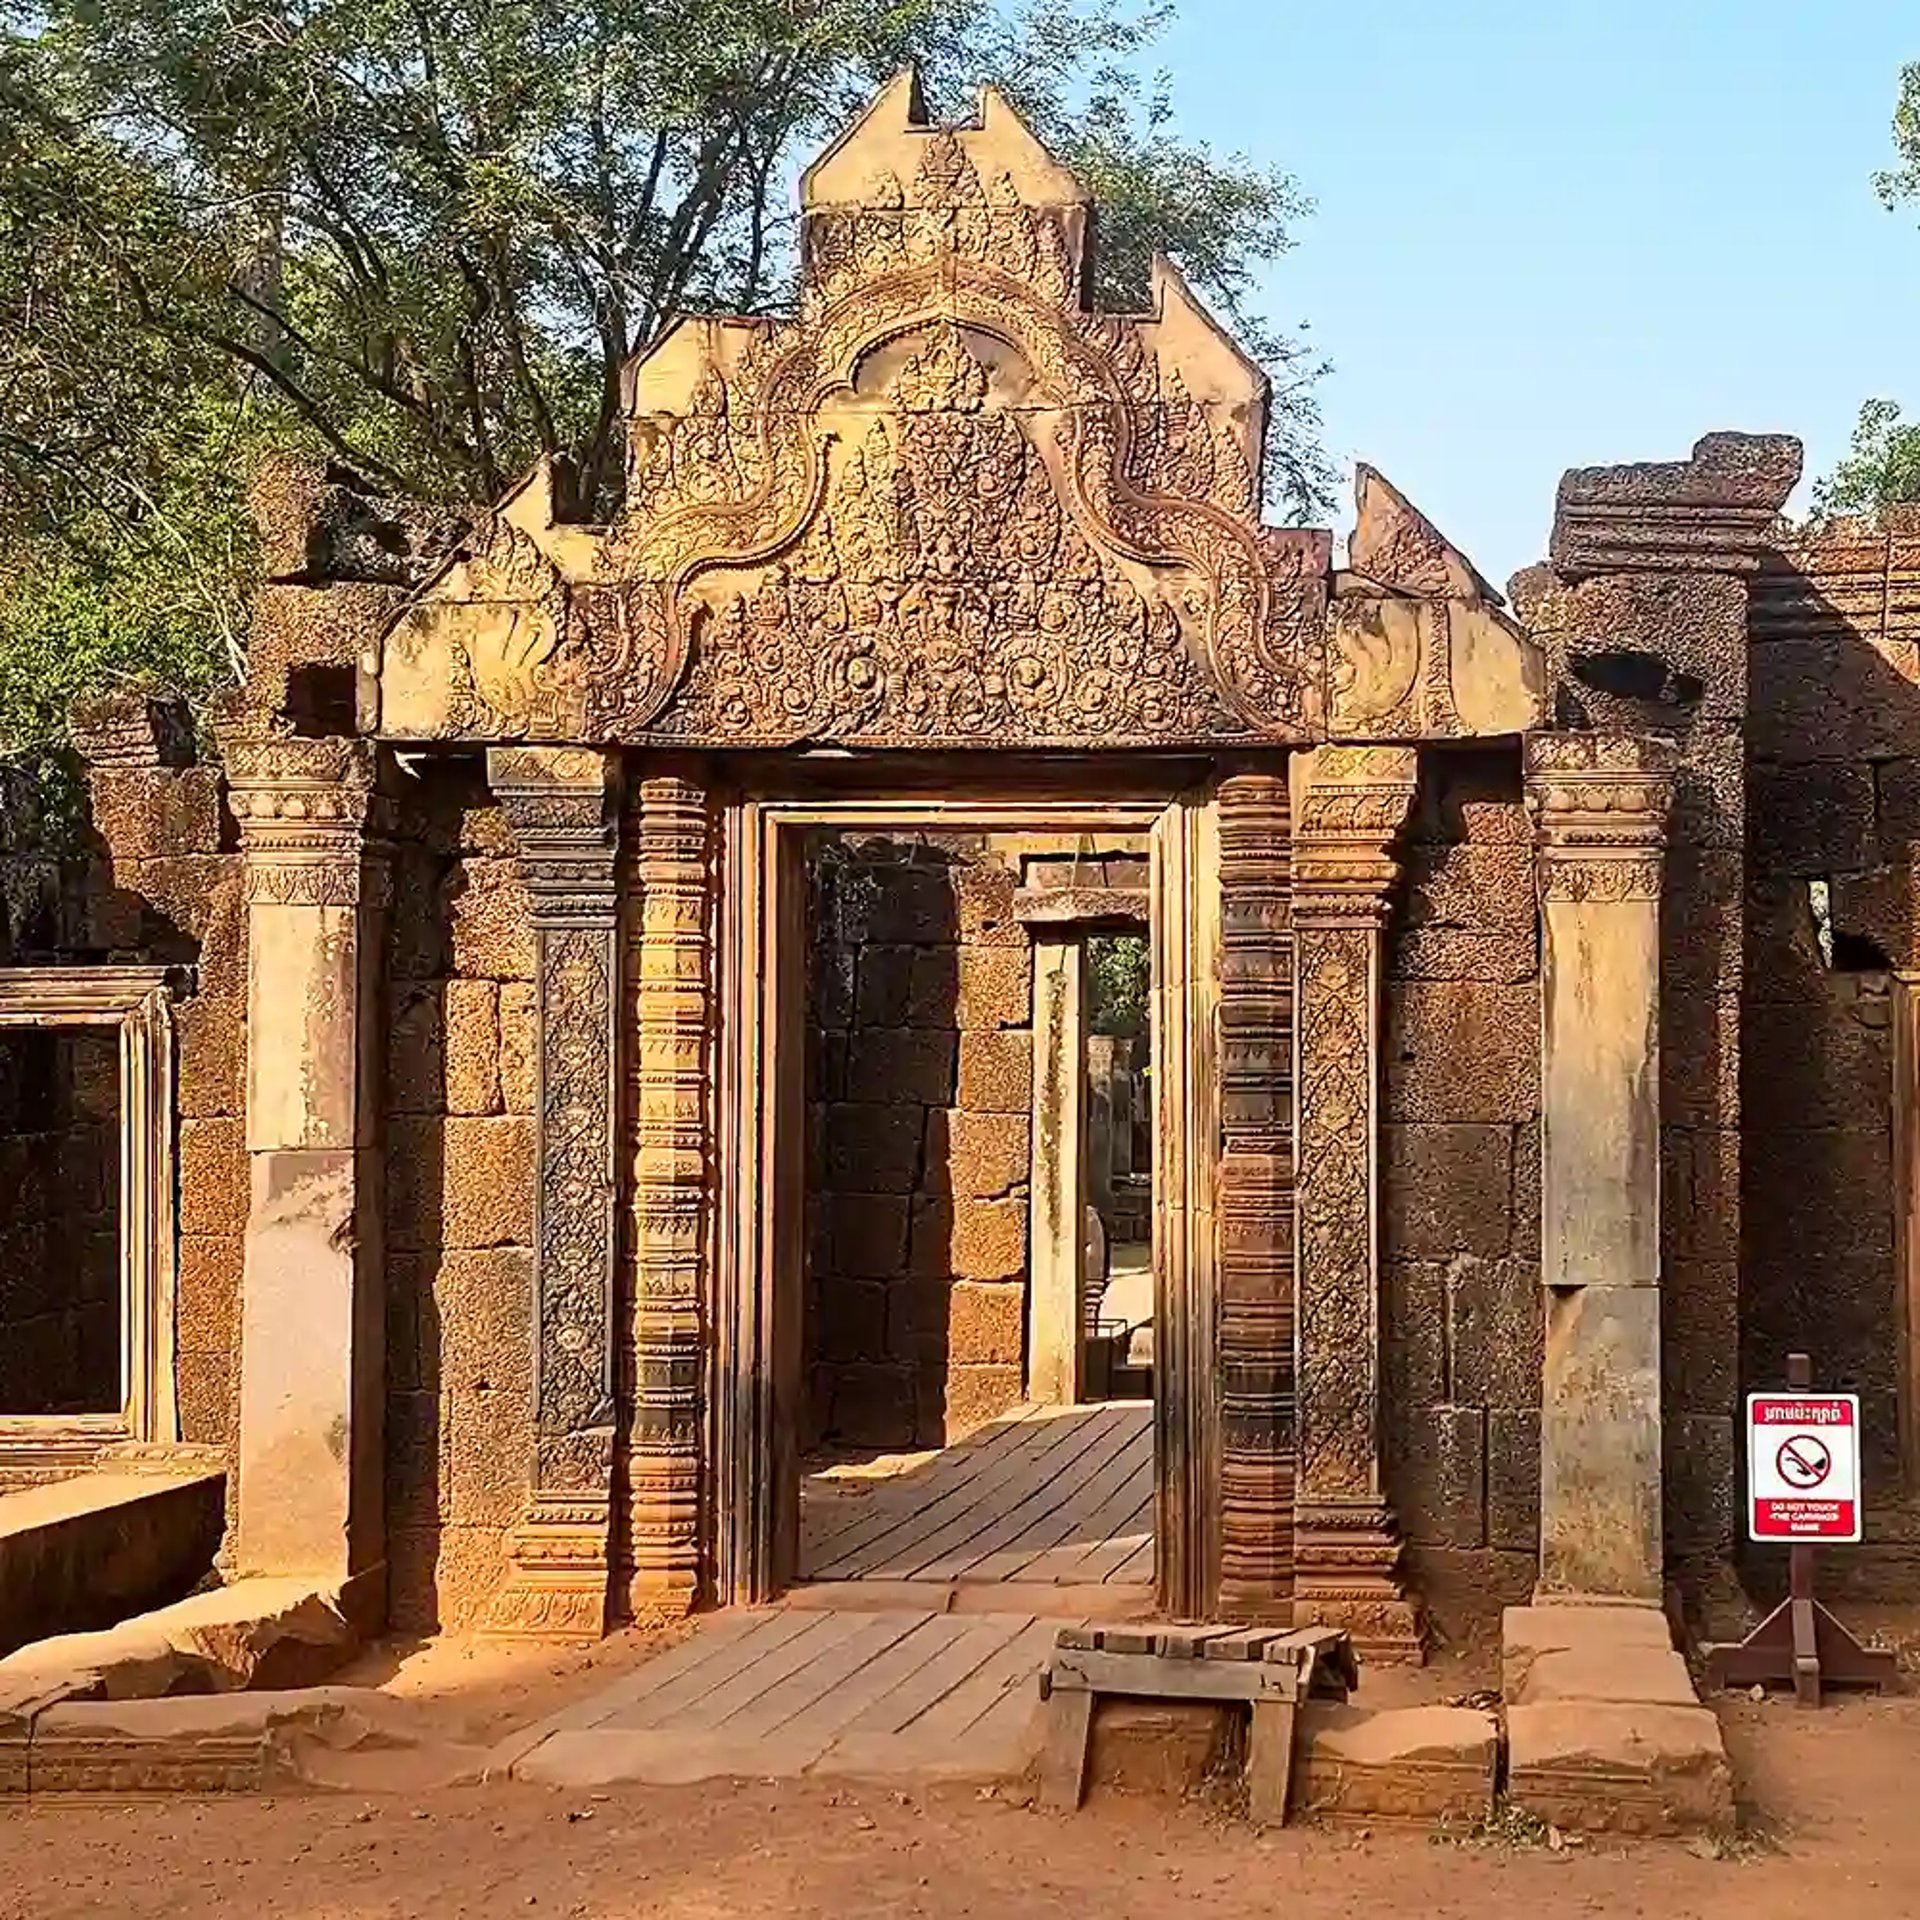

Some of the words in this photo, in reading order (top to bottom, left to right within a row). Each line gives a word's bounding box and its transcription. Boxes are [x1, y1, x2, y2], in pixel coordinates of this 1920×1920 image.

[1771, 1503, 1784, 1511] DO
[1787, 1503, 1805, 1511] NOT
[1807, 1503, 1838, 1511] TOUCH
